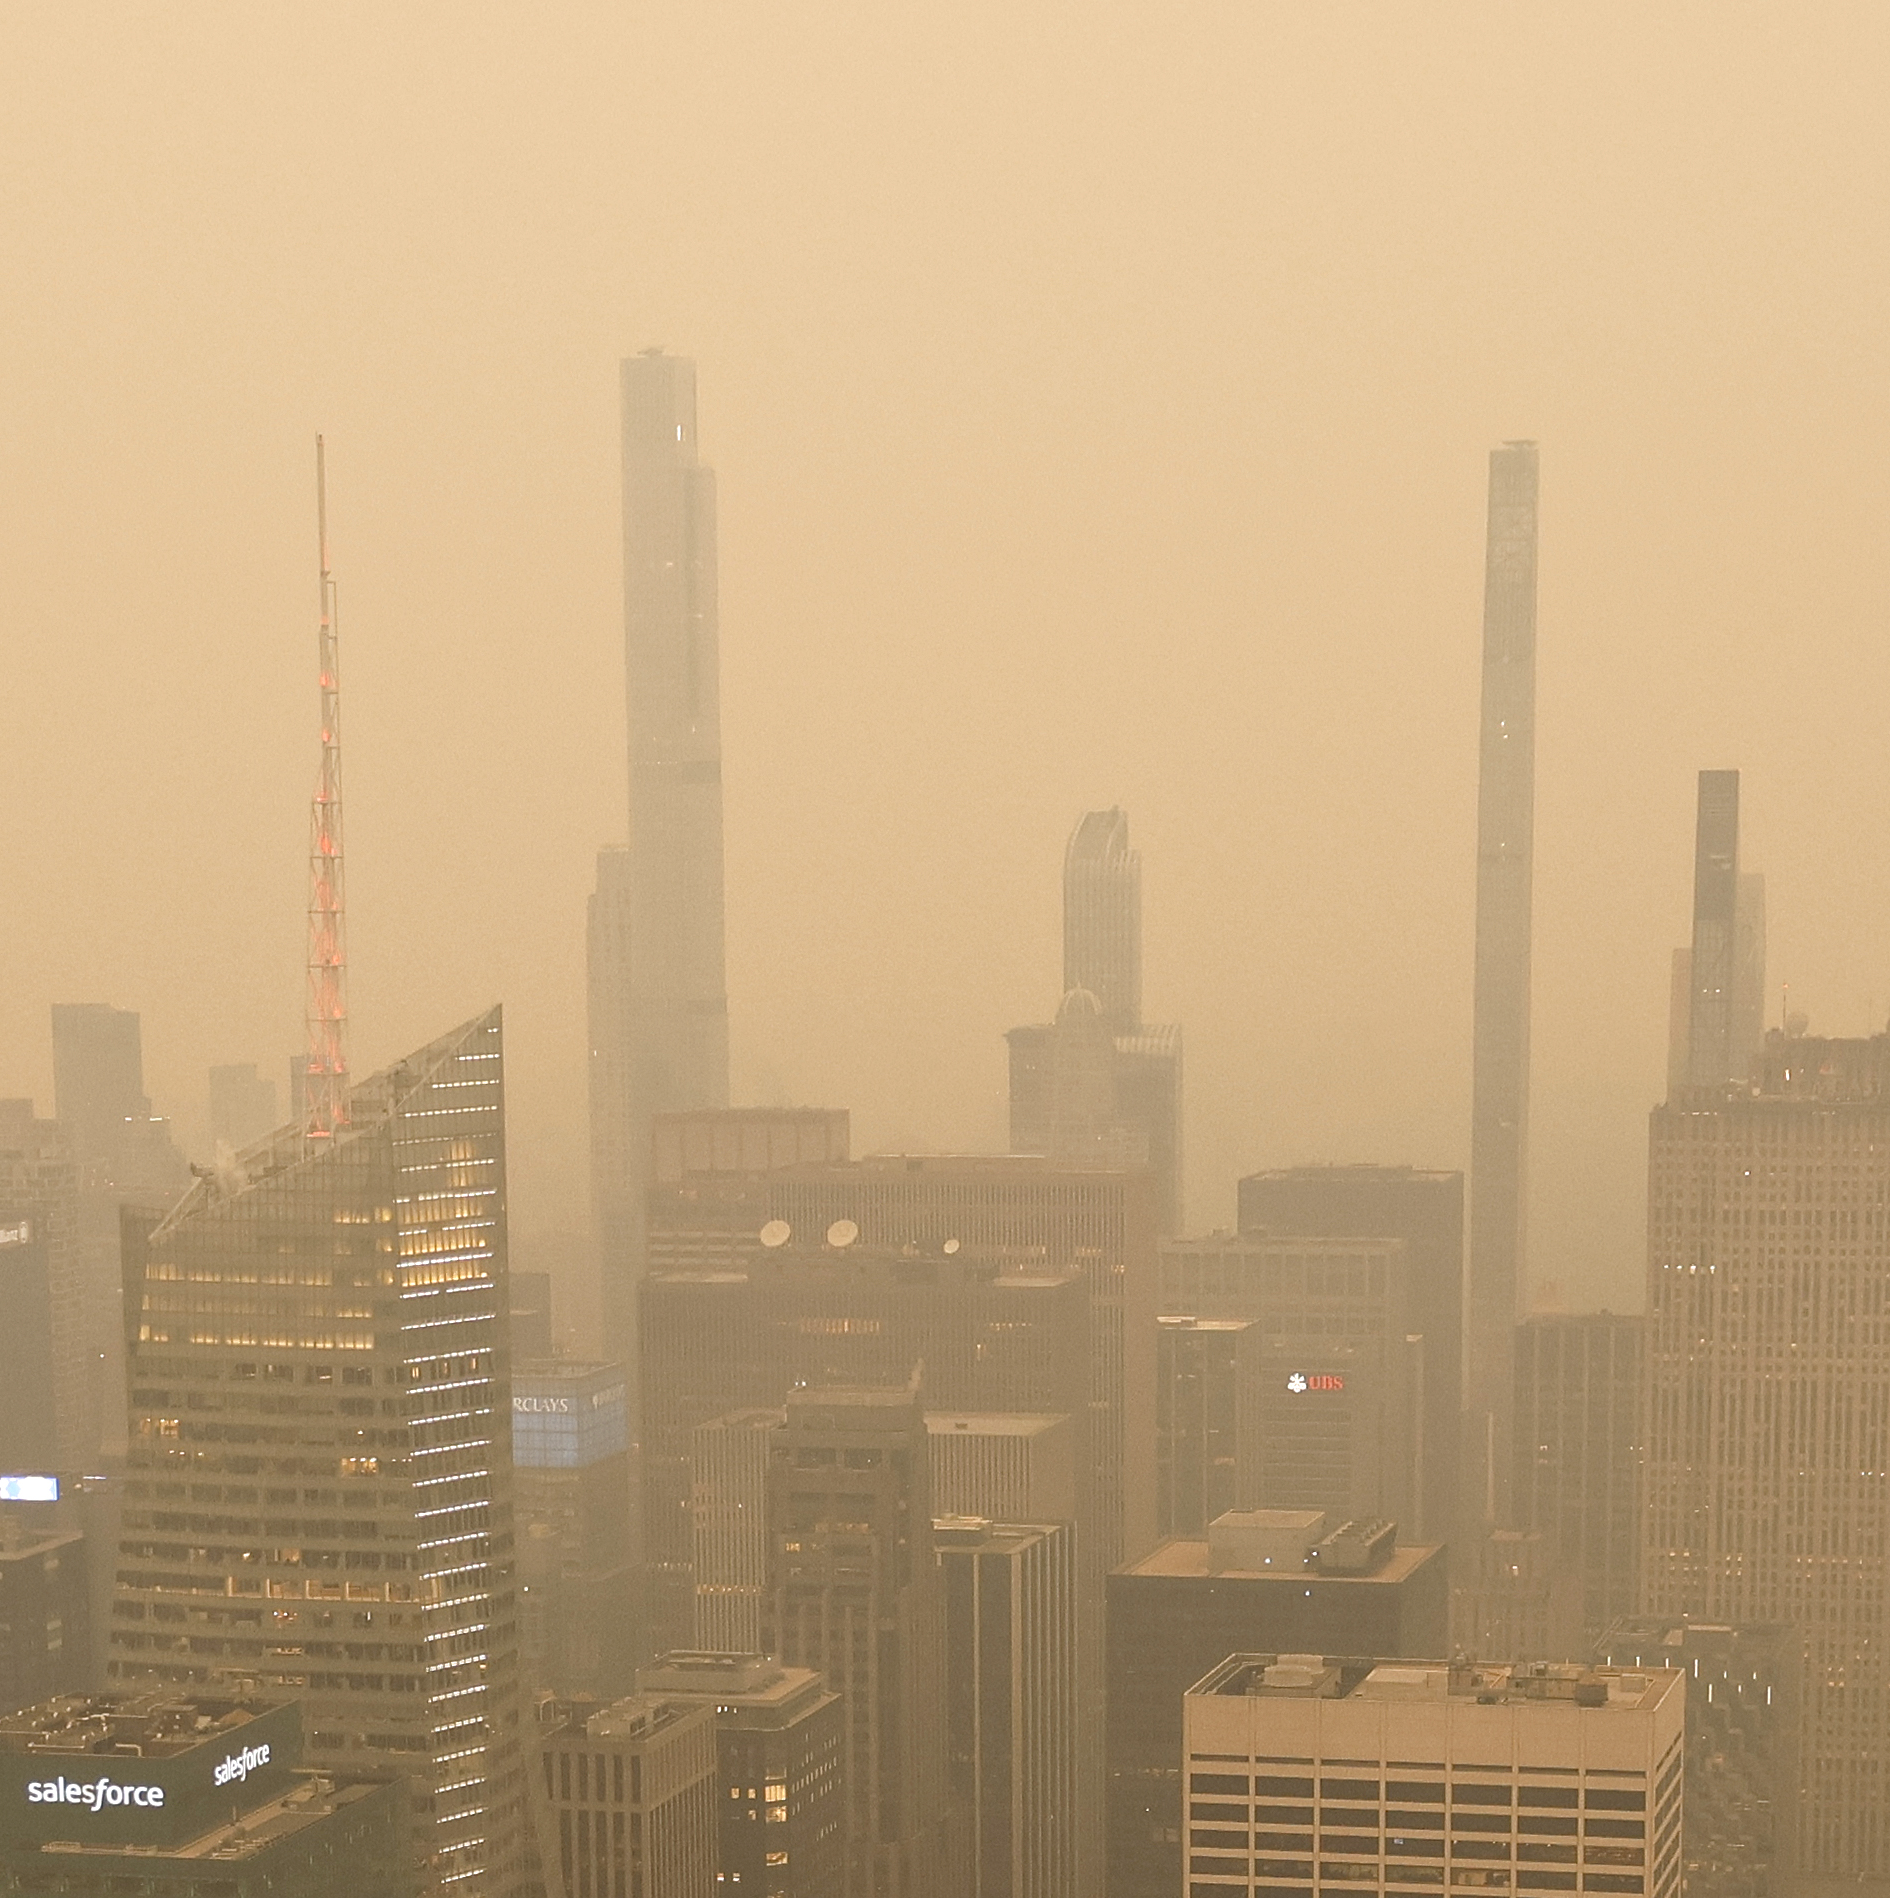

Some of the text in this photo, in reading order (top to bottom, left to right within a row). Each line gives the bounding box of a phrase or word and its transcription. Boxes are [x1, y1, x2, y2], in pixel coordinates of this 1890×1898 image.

[1308, 1375, 1344, 1391] UBS
[513, 1397, 569, 1412] RCLAYS
[214, 1744, 270, 1786] salesforce
[28, 1776, 164, 1811] salesforce
